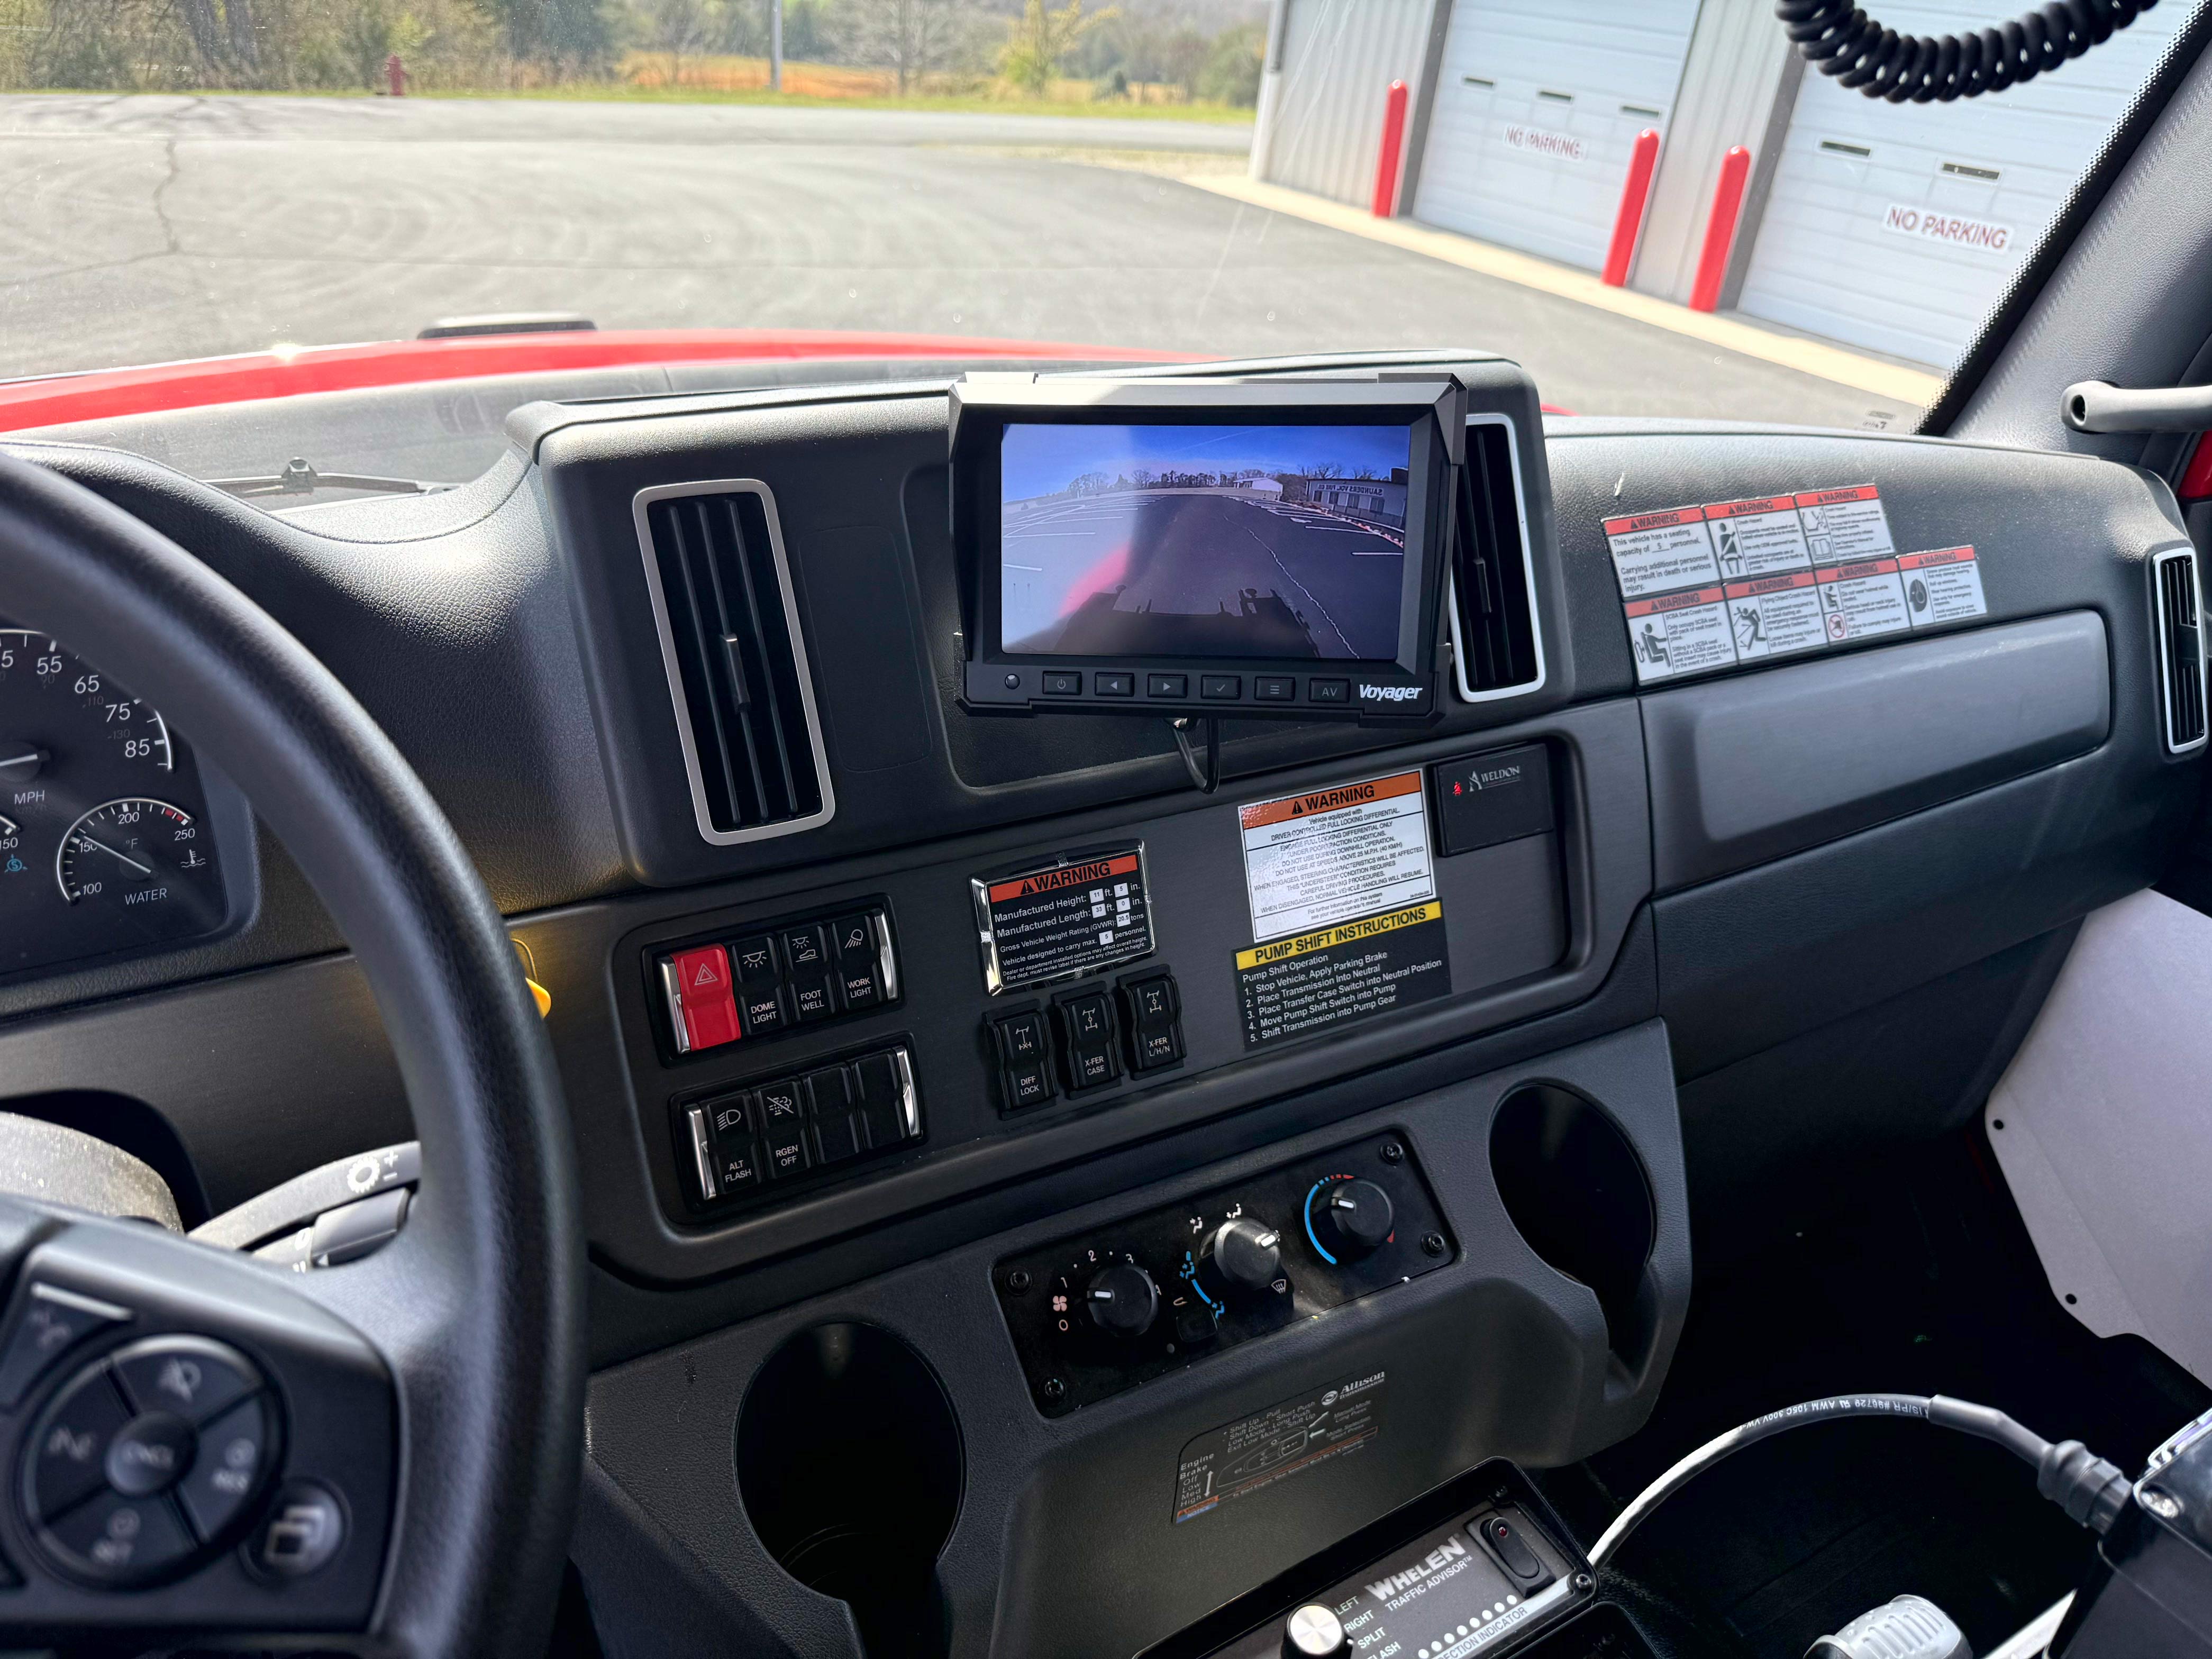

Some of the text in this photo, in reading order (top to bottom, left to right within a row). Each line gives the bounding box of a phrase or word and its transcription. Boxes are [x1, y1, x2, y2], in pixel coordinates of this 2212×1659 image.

[1887, 206, 2007, 249] NO PARKING
[1824, 490, 1859, 502] WARNING
[1734, 501, 1773, 514] WARNING
[1636, 513, 1679, 527] WARNING
[1628, 534, 1650, 543] vehicle
[1668, 529, 1690, 537] seating
[1616, 547, 1641, 557] capacity
[1925, 552, 1957, 564] WARNING
[1621, 554, 1708, 575] Carrying additional personnel
[1657, 592, 1700, 608] WARNING
[37, 655, 62, 674] 55
[74, 674, 99, 694] 65
[1322, 684, 1423, 701] AV Voyager
[105, 703, 131, 723] 75
[125, 739, 150, 758] 85
[1481, 765, 1520, 782] WELDON
[14, 790, 45, 805] MPH
[1305, 785, 1374, 810] WARNING
[118, 812, 140, 824] 200
[1308, 816, 1327, 824] Vehicle
[1328, 810, 1351, 821] equipped
[175, 828, 196, 841] 250
[1034, 862, 1110, 890] WARNING
[83, 882, 102, 895] 100
[125, 888, 167, 905] WATER
[994, 901, 1054, 922] Manufactured
[1056, 895, 1086, 908] Height:
[997, 916, 1057, 937] Manufactured
[1058, 909, 1090, 923] Length:
[1000, 944, 1019, 952] Gross
[1021, 937, 1044, 947] Vehicle
[1045, 931, 1068, 941] Weight
[1069, 927, 1089, 935] Rating
[1090, 919, 1116, 931] (GVWR):
[1255, 907, 1426, 962] PUMP SHIFT INSTRUCTIONS
[1002, 956, 1025, 965] Vehicle
[1027, 947, 1055, 960] designed
[1115, 926, 1146, 939] personnel.
[1025, 960, 1052, 970] department
[1053, 954, 1073, 963] installed
[1242, 955, 1328, 982] Pump Shift Operation
[1255, 982, 1275, 992] Stop
[1276, 973, 1307, 986] Vehicle,
[1309, 966, 1332, 978] Apply
[1333, 958, 1363, 971] Parking
[1364, 952, 1387, 963] Brake
[848, 977, 871, 989] WORK
[1245, 963, 1380, 1007] 2. Place Transmission Into Neutral
[1259, 1005, 1280, 1016] Place
[1282, 995, 1315, 1008] Transfer
[1317, 989, 1336, 999] Case
[1338, 980, 1364, 993] Switch
[1366, 977, 1381, 986] into
[1382, 967, 1409, 981] Neutral
[1410, 960, 1441, 973] Position
[800, 990, 822, 1001] FOOT
[850, 987, 872, 998] LIGHT
[751, 1001, 776, 1014] DOME
[802, 1000, 824, 1011] WELL
[753, 1011, 777, 1024] LIGHT
[1149, 1037, 1168, 1047] X-FER
[1149, 1045, 1170, 1057] L/H/N
[1085, 1056, 1104, 1067] X-FER
[1087, 1065, 1105, 1075] CASE
[1021, 1075, 1036, 1086] DIFF
[1021, 1084, 1039, 1096] LOCK
[776, 1144, 798, 1157] RGEN
[729, 1160, 743, 1171] ALT
[781, 1155, 797, 1166] OFF
[725, 1169, 751, 1183] FLASH
[1088, 1250, 1096, 1261] 2
[1060, 1277, 1067, 1288] 1
[1341, 1371, 1385, 1395] Allison
[1786, 1406, 1807, 1416] 105C
[1812, 1400, 1835, 1409] AWM
[1762, 1411, 1783, 1423] 300V
[1180, 1453, 1214, 1470] Engine
[1180, 1465, 1207, 1479] Brake
[1183, 1474, 1198, 1485] Off
[1181, 1488, 1200, 1500] Med
[1182, 1482, 1200, 1493] Low
[1180, 1495, 1201, 1507] High
[1364, 1535, 1466, 1601] WHELEN
[1385, 1579, 1426, 1612] TRAFFIC
[1334, 1596, 1360, 1616] LEFT
[1343, 1609, 1375, 1633] RIGHT
[1479, 1607, 1528, 1642] INDICATOR
[1358, 1627, 1386, 1649] SPLIT
